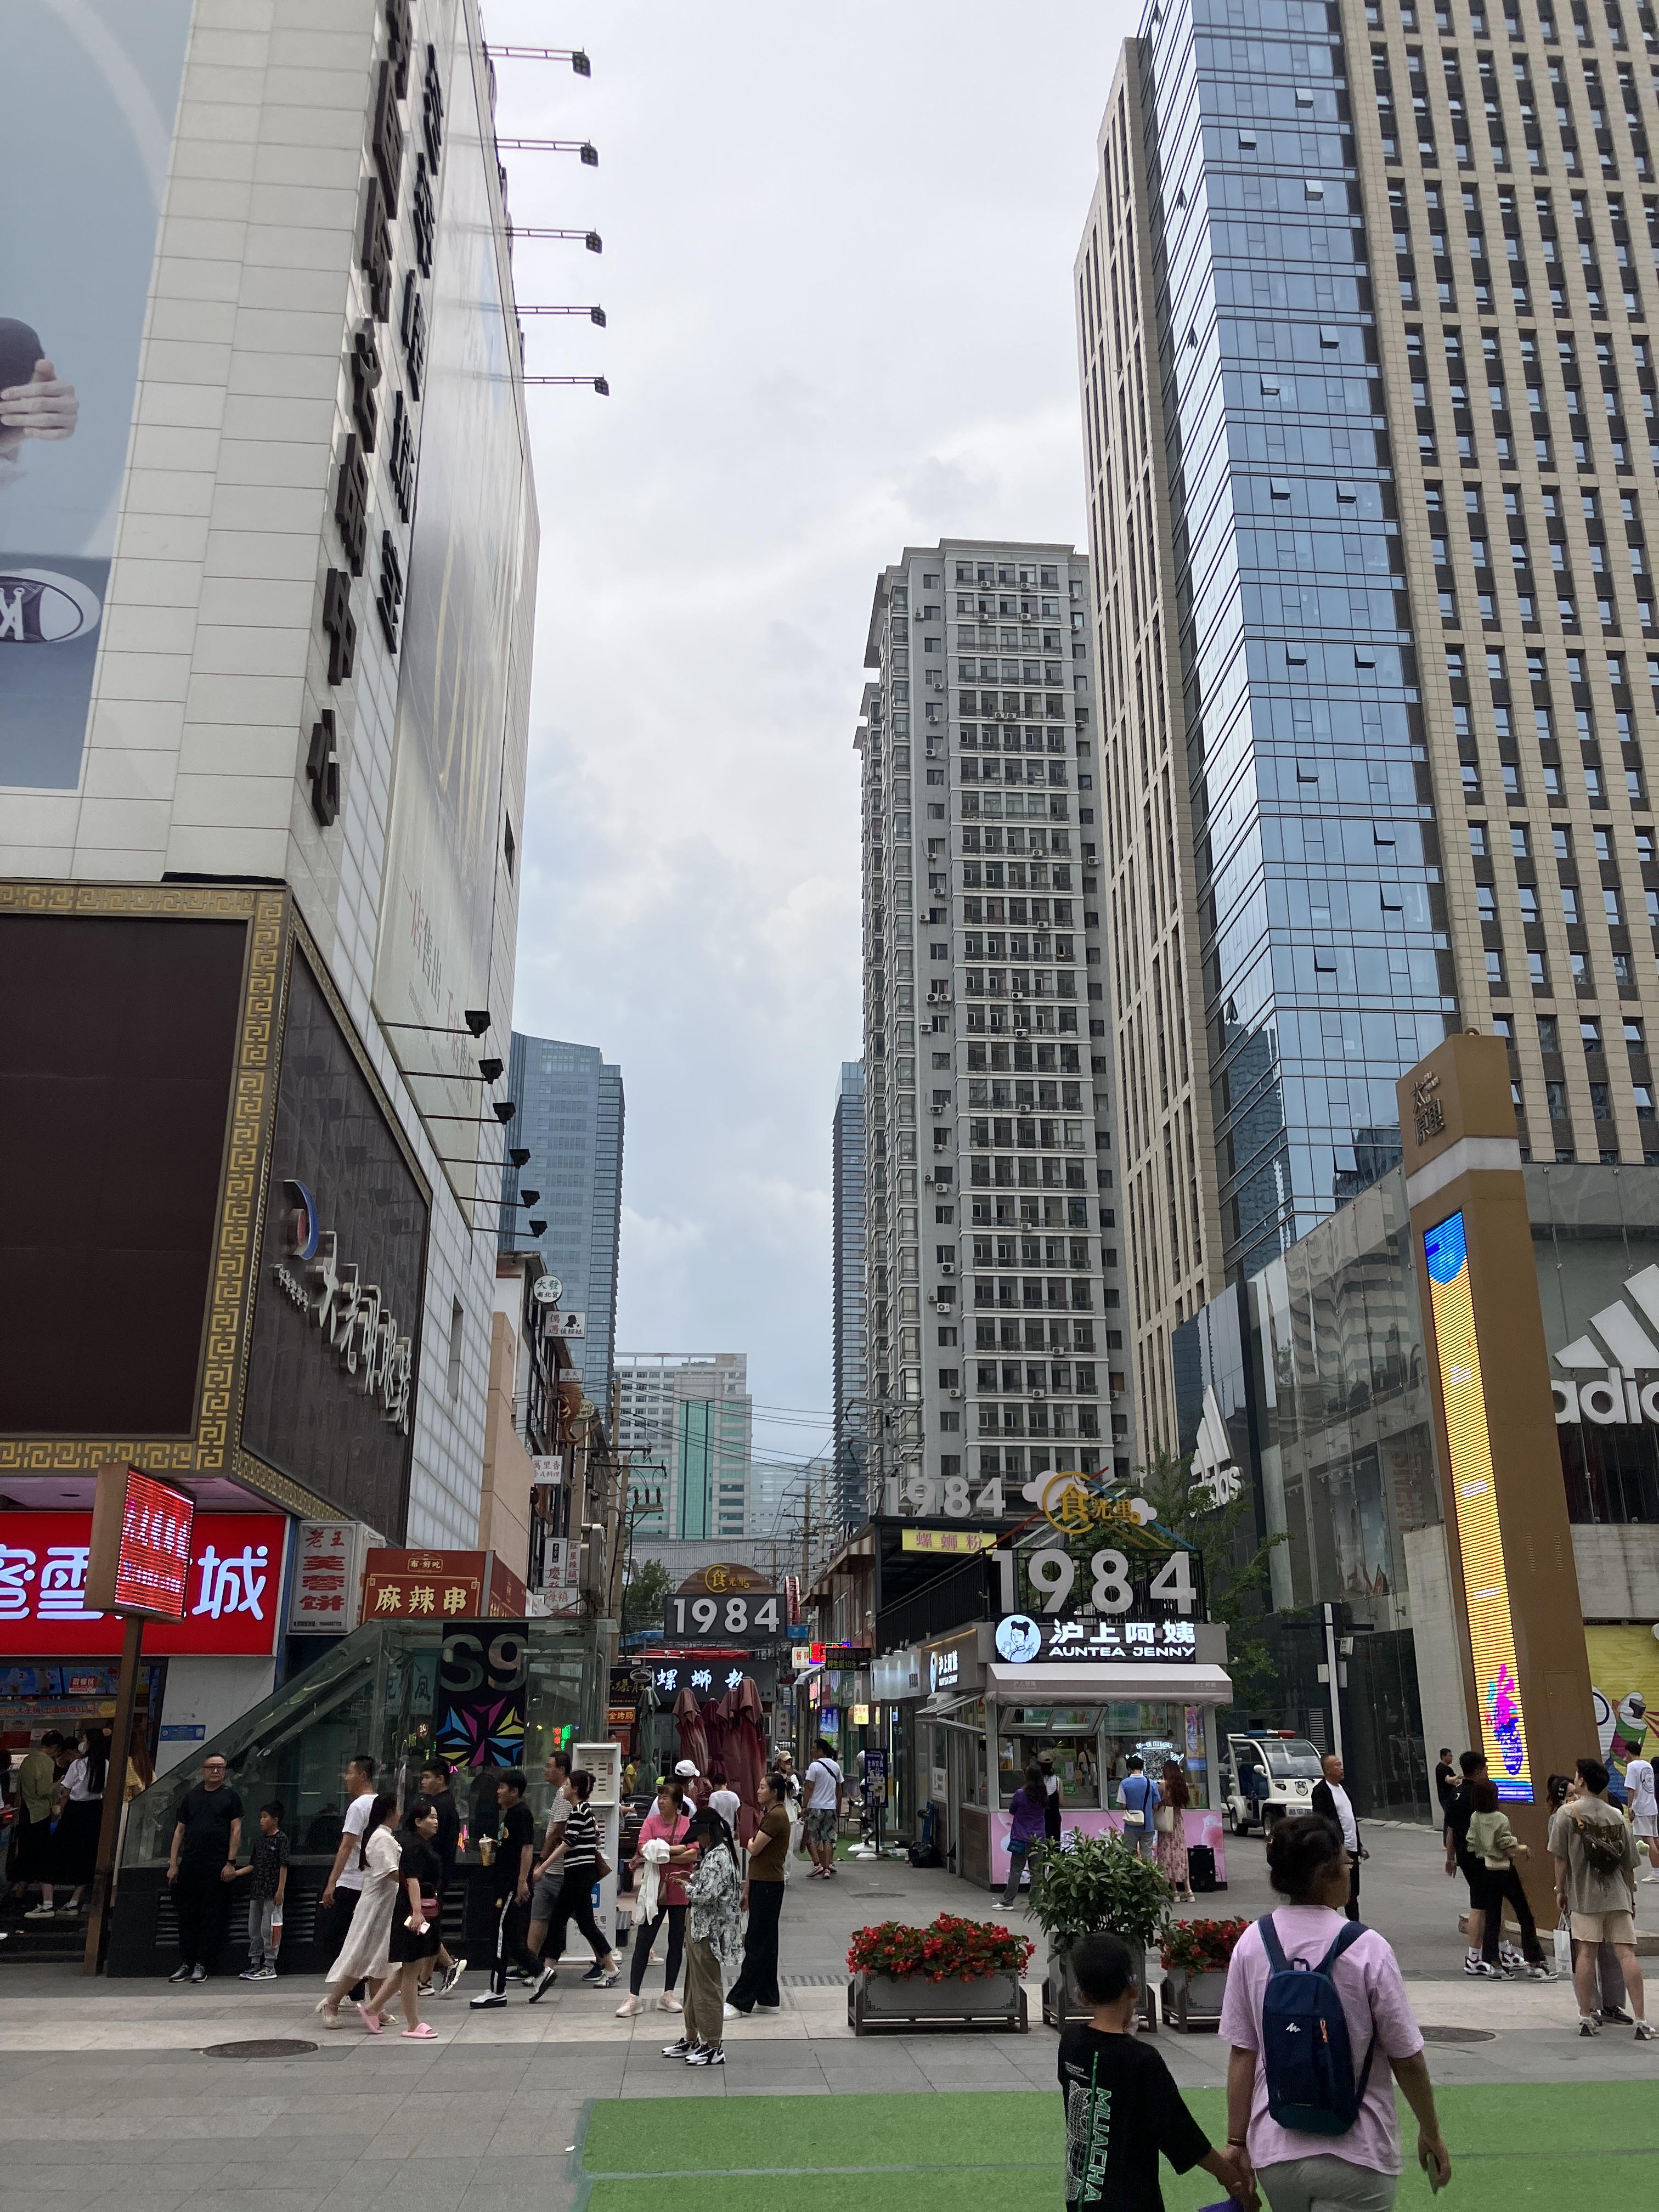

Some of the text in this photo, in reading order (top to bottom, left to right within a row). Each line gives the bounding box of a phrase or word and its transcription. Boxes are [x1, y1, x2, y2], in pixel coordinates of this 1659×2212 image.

[537, 1279, 560, 1290] 大發
[314, 1231, 411, 1436] 大光明眼镜
[885, 1476, 1006, 1518] 1984
[305, 1530, 345, 1548] 老王
[0, 1545, 268, 1621] 蜜雪城
[299, 1555, 346, 1611] 芙蓉饼
[374, 1584, 467, 1615] 麻辣串
[992, 1549, 1197, 1614] 1984
[674, 1598, 780, 1634] 1984
[1048, 1619, 1195, 1644] 沪上阿姨
[439, 1633, 527, 1691] S9
[1048, 1646, 1195, 1657] AUNTEA JENNY
[1084, 2087, 1112, 2202] MLIACHA
